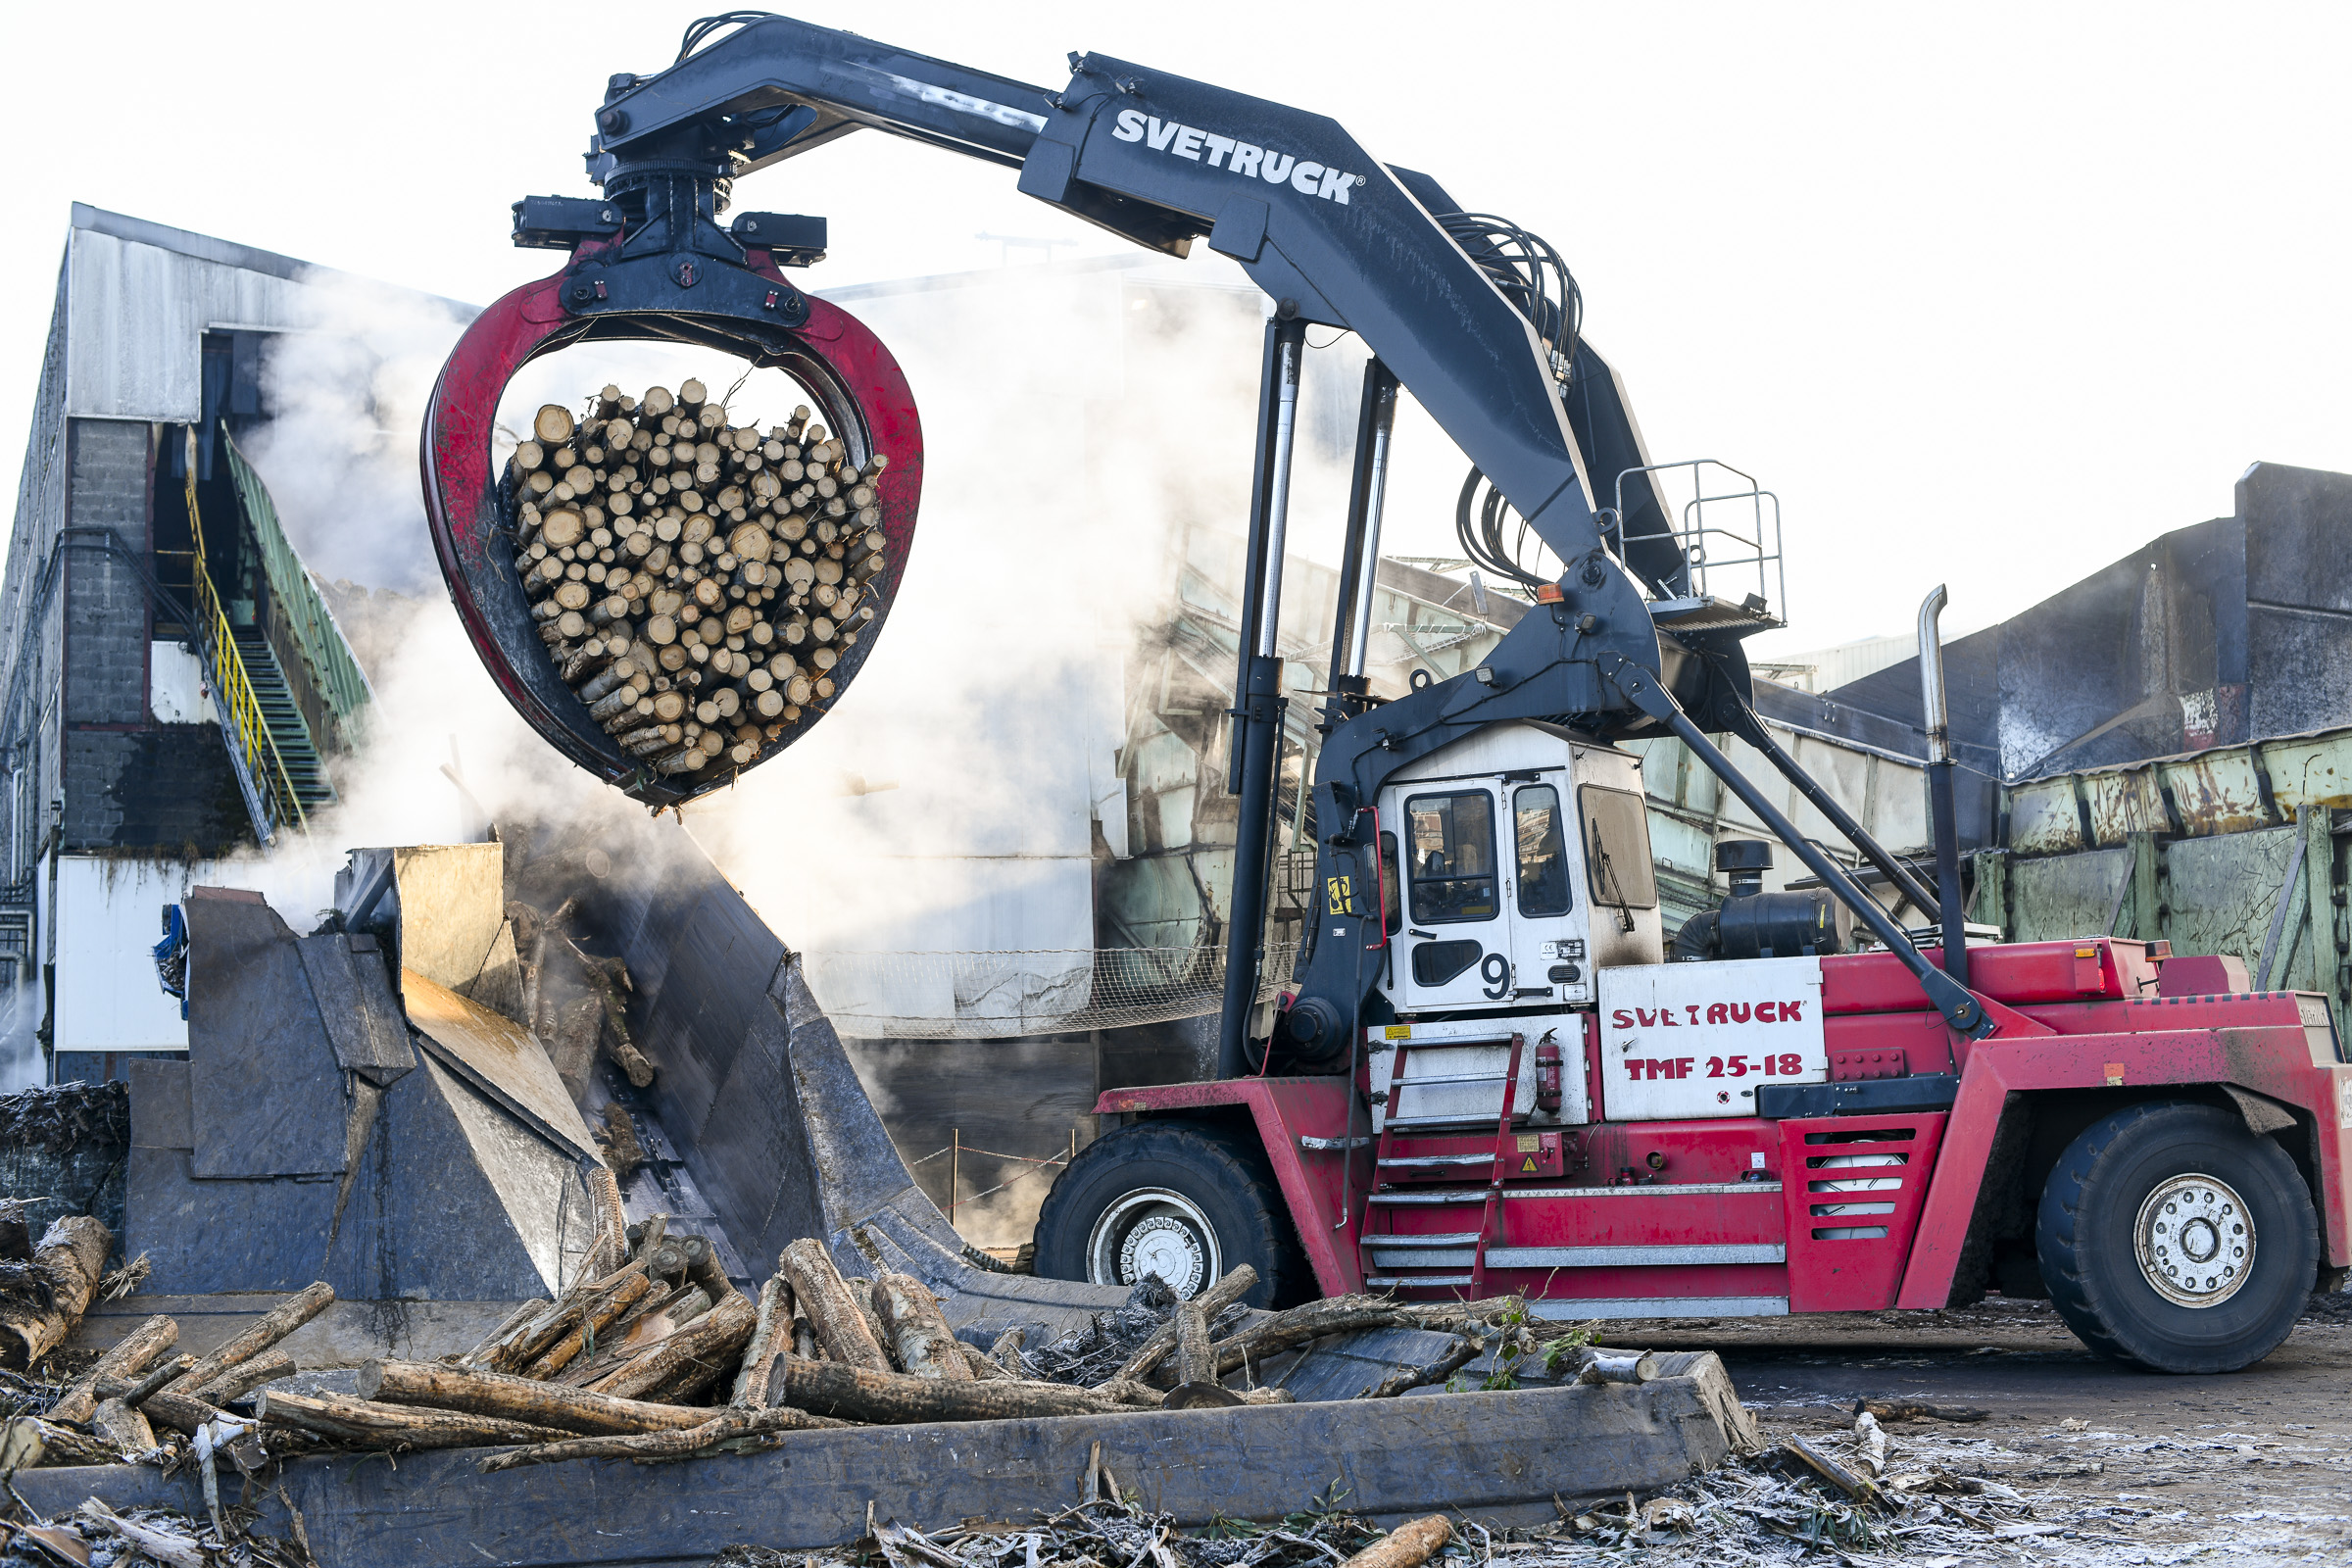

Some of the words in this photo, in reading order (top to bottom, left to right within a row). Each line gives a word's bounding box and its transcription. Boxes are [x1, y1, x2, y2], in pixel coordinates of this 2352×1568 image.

[1481, 953, 1511, 1000] 9
[1624, 1057, 1695, 1080] TMF
[1705, 1054, 1803, 1078] 25-18
